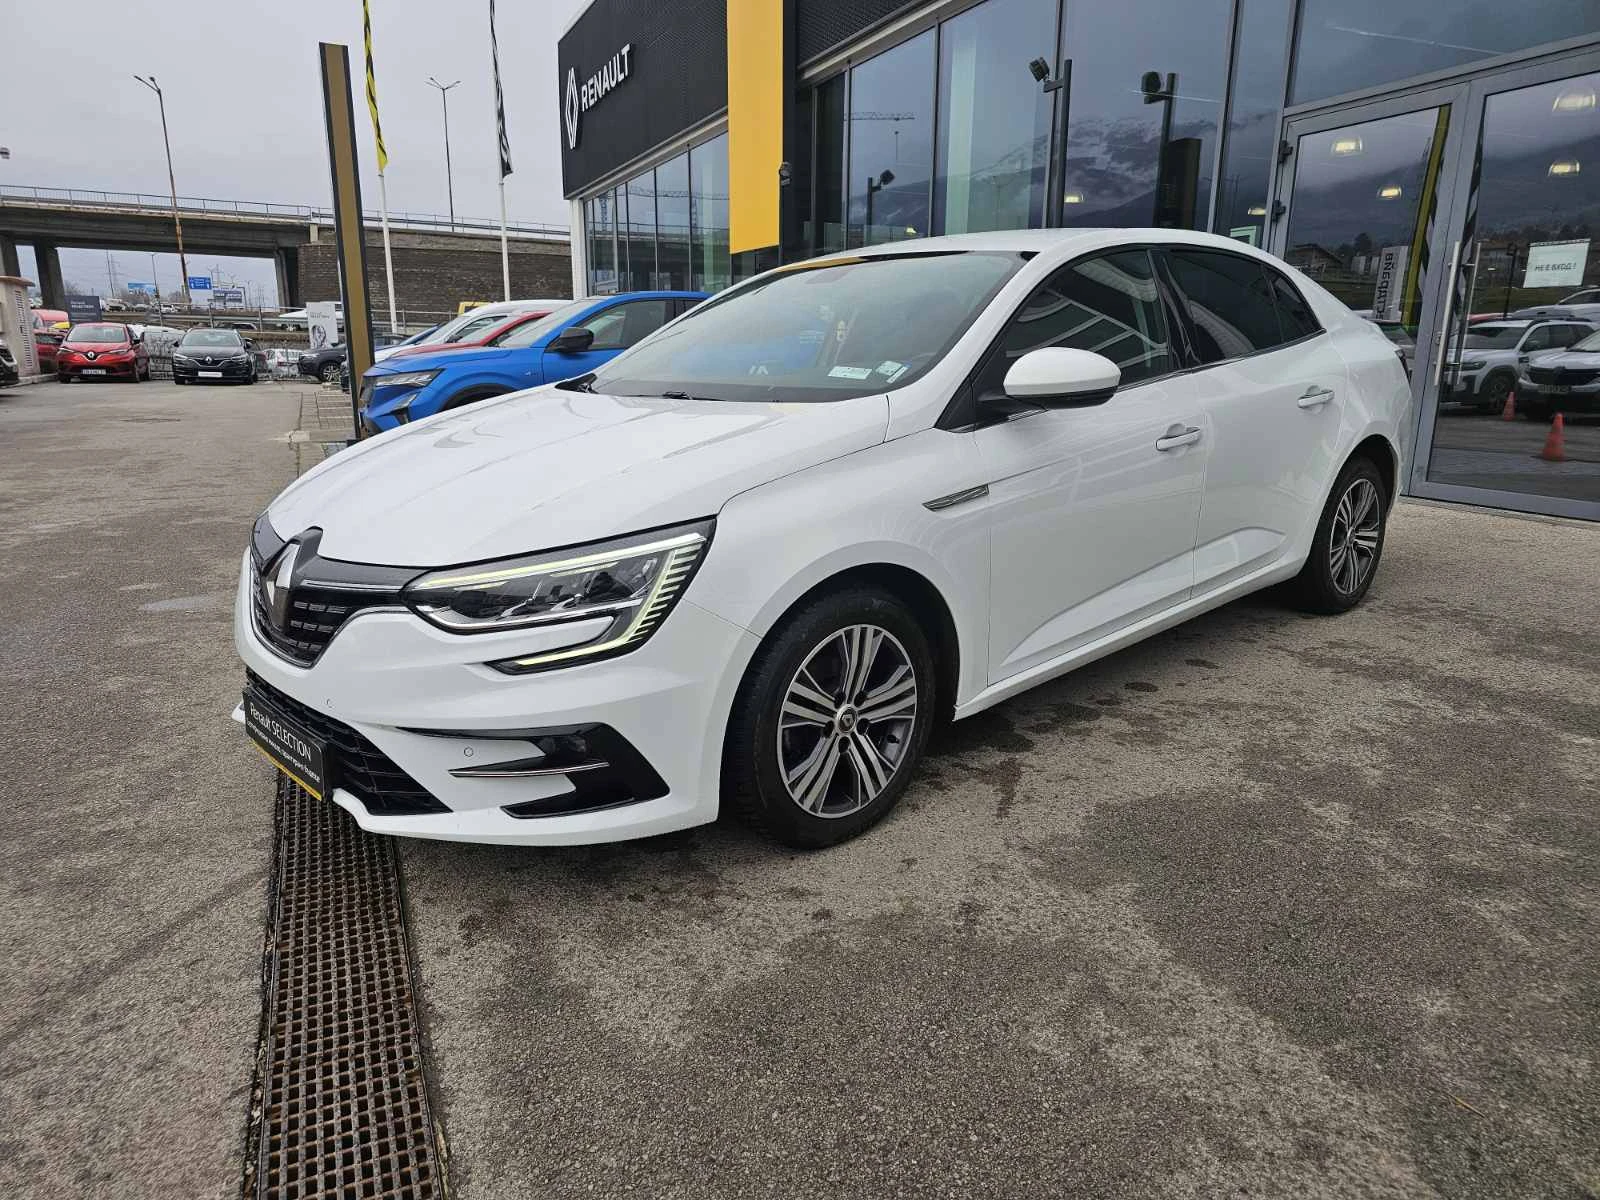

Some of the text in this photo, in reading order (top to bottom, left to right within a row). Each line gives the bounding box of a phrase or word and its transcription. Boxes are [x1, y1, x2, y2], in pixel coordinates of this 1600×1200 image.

[581, 43, 631, 112] RENAULT
[250, 702, 271, 731] Renault
[272, 720, 312, 761] SELECTION
